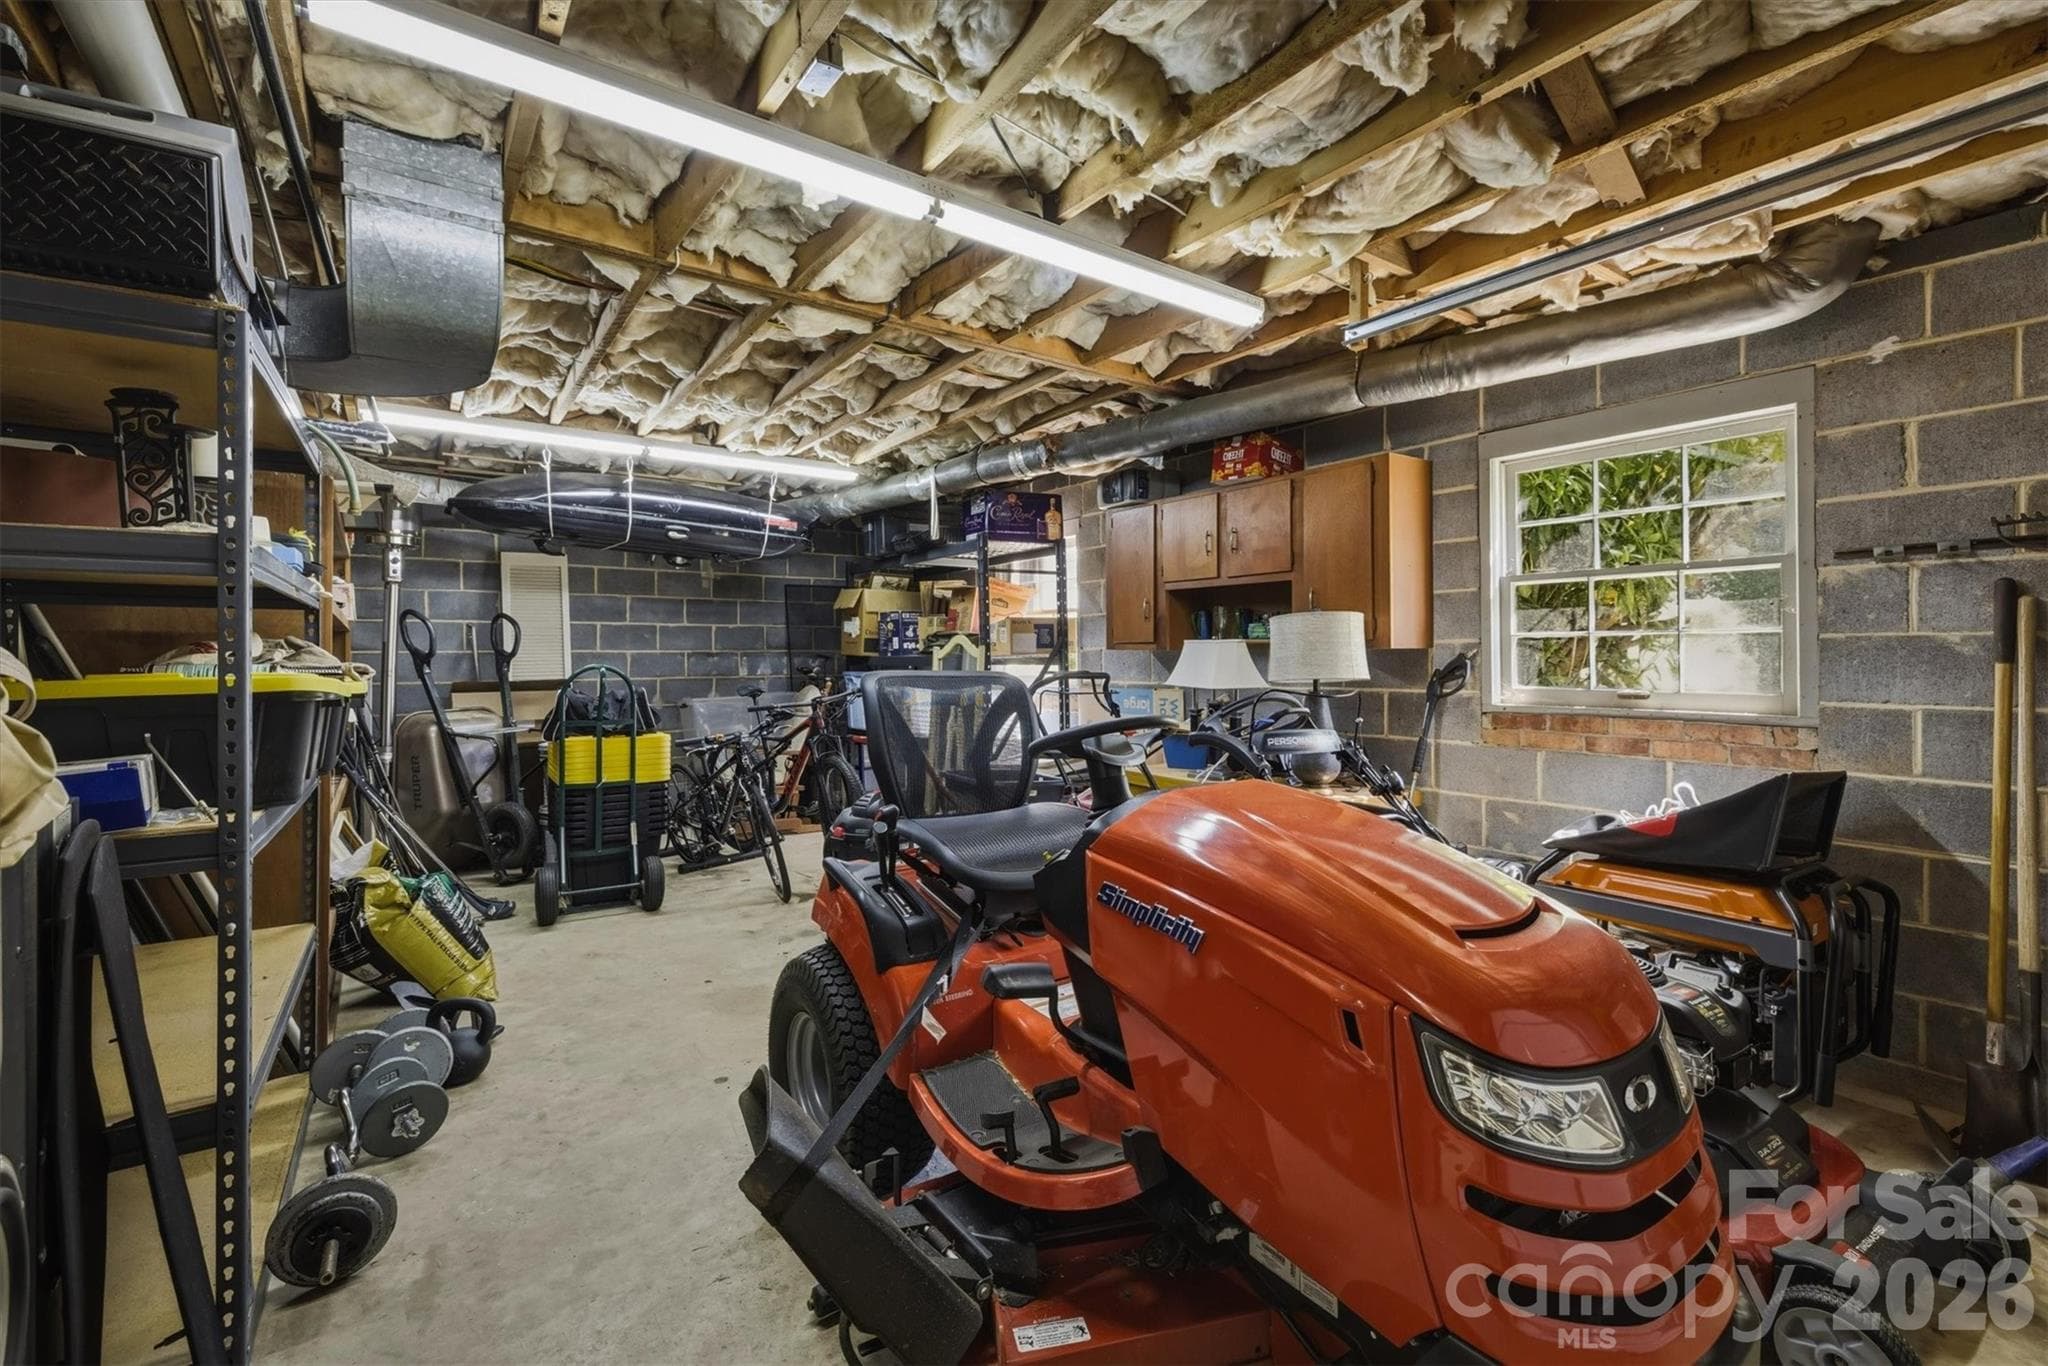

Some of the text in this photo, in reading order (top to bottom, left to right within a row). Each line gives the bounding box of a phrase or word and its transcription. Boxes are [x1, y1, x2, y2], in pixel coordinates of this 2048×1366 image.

[1123, 696, 1151, 713] large
[411, 755, 422, 811] TRUPER
[1097, 880, 1206, 955] Simplicity
